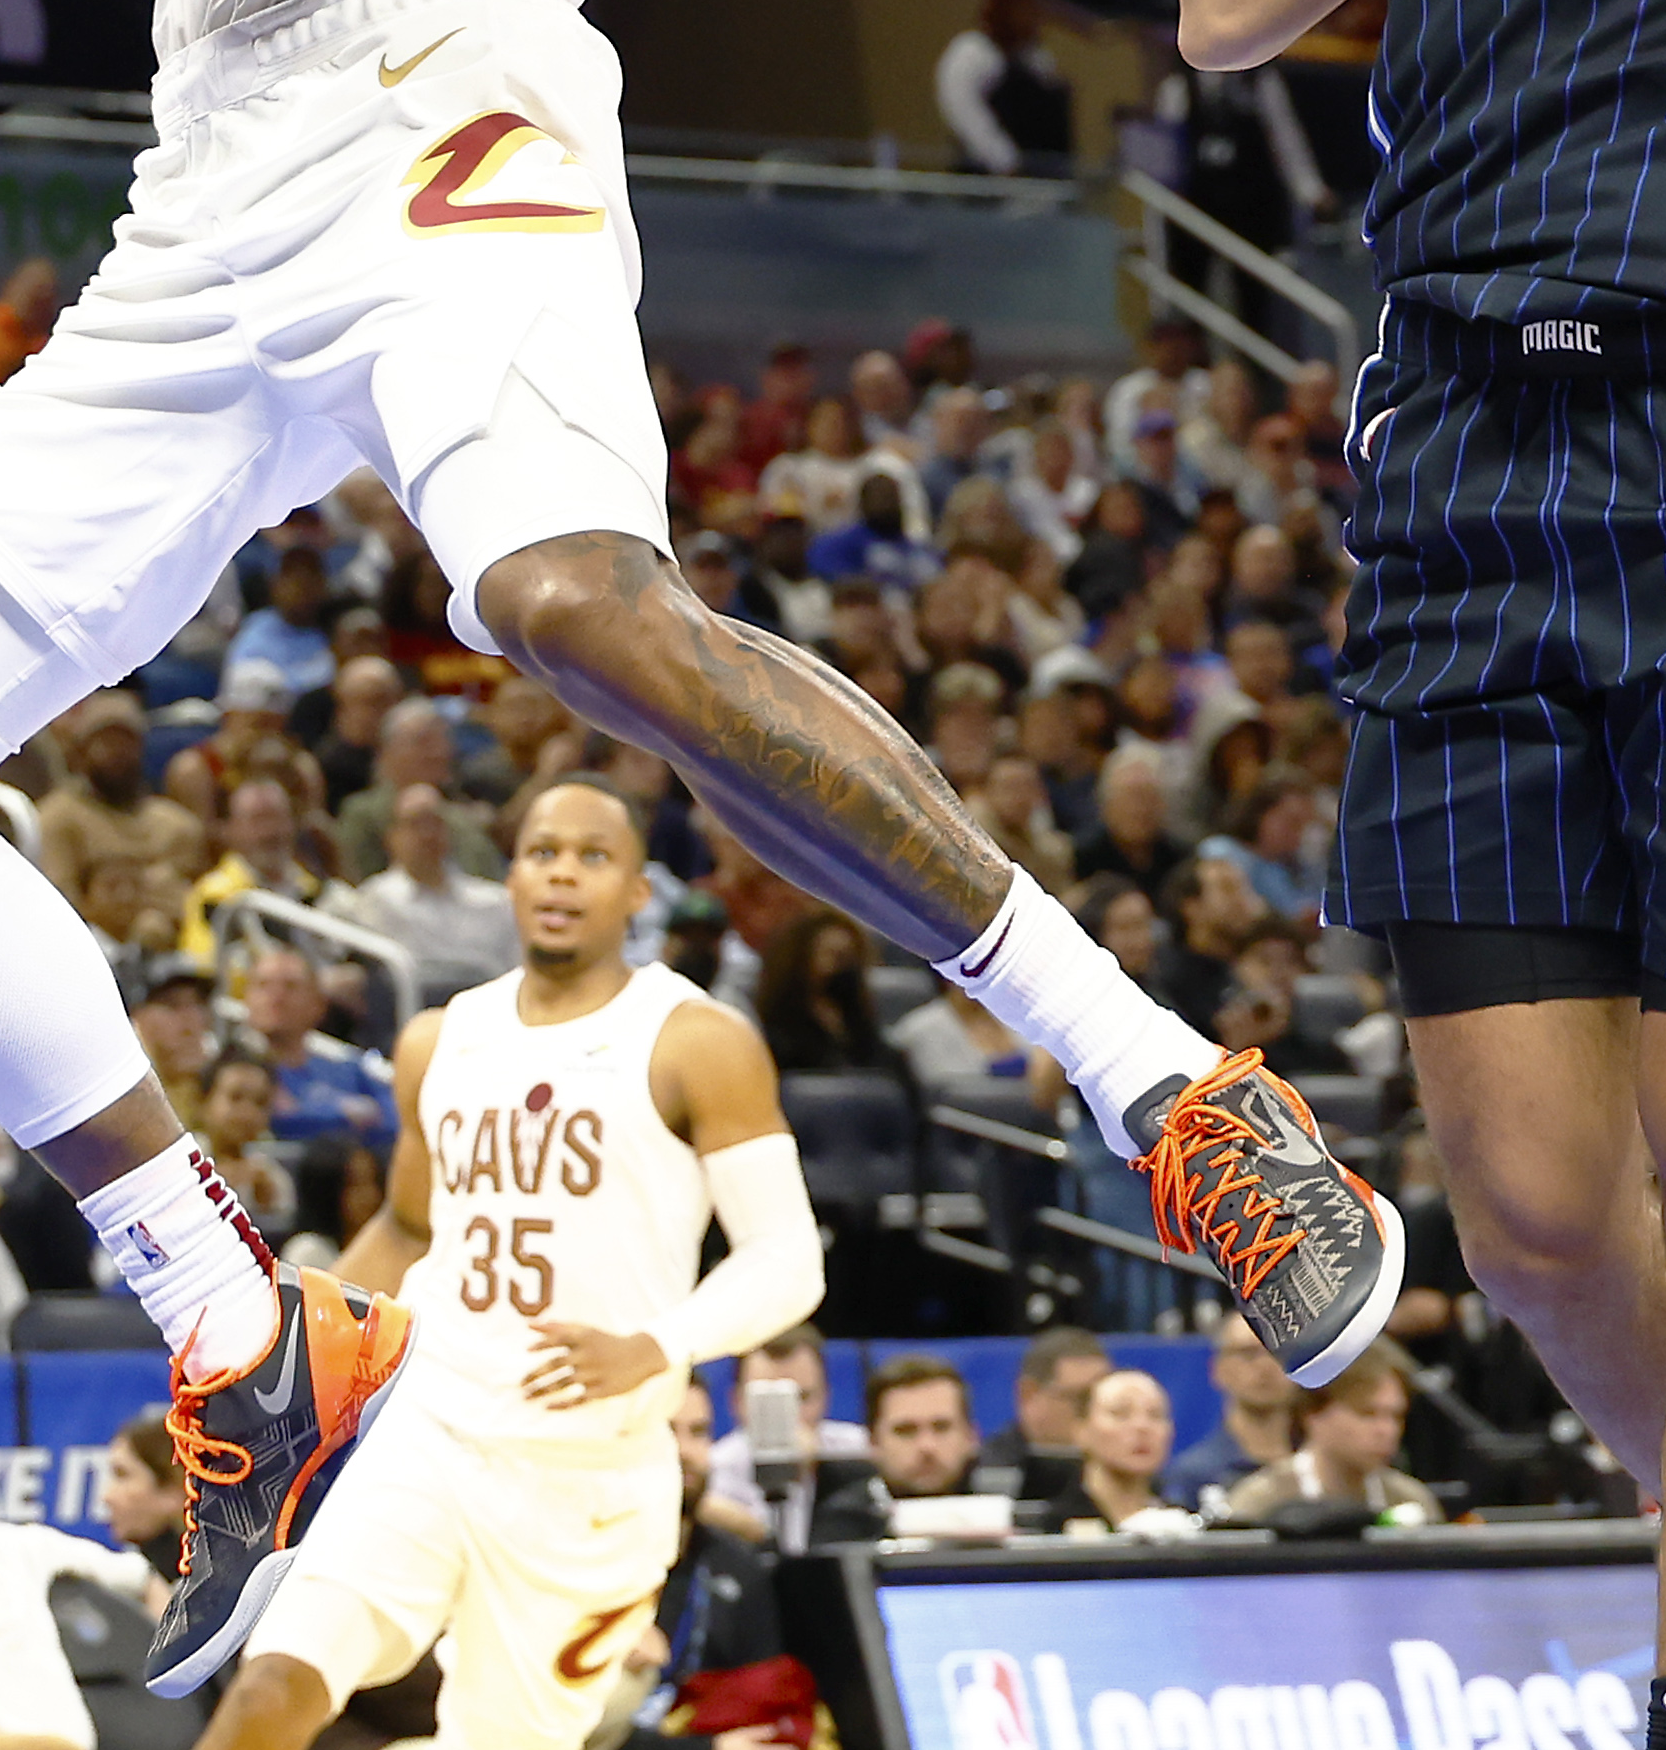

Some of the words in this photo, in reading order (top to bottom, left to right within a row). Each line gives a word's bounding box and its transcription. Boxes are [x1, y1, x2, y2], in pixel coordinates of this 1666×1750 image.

[1521, 318, 1603, 356] MAGIC
[437, 1108, 603, 1198] CAVS
[460, 1214, 555, 1318] 35
